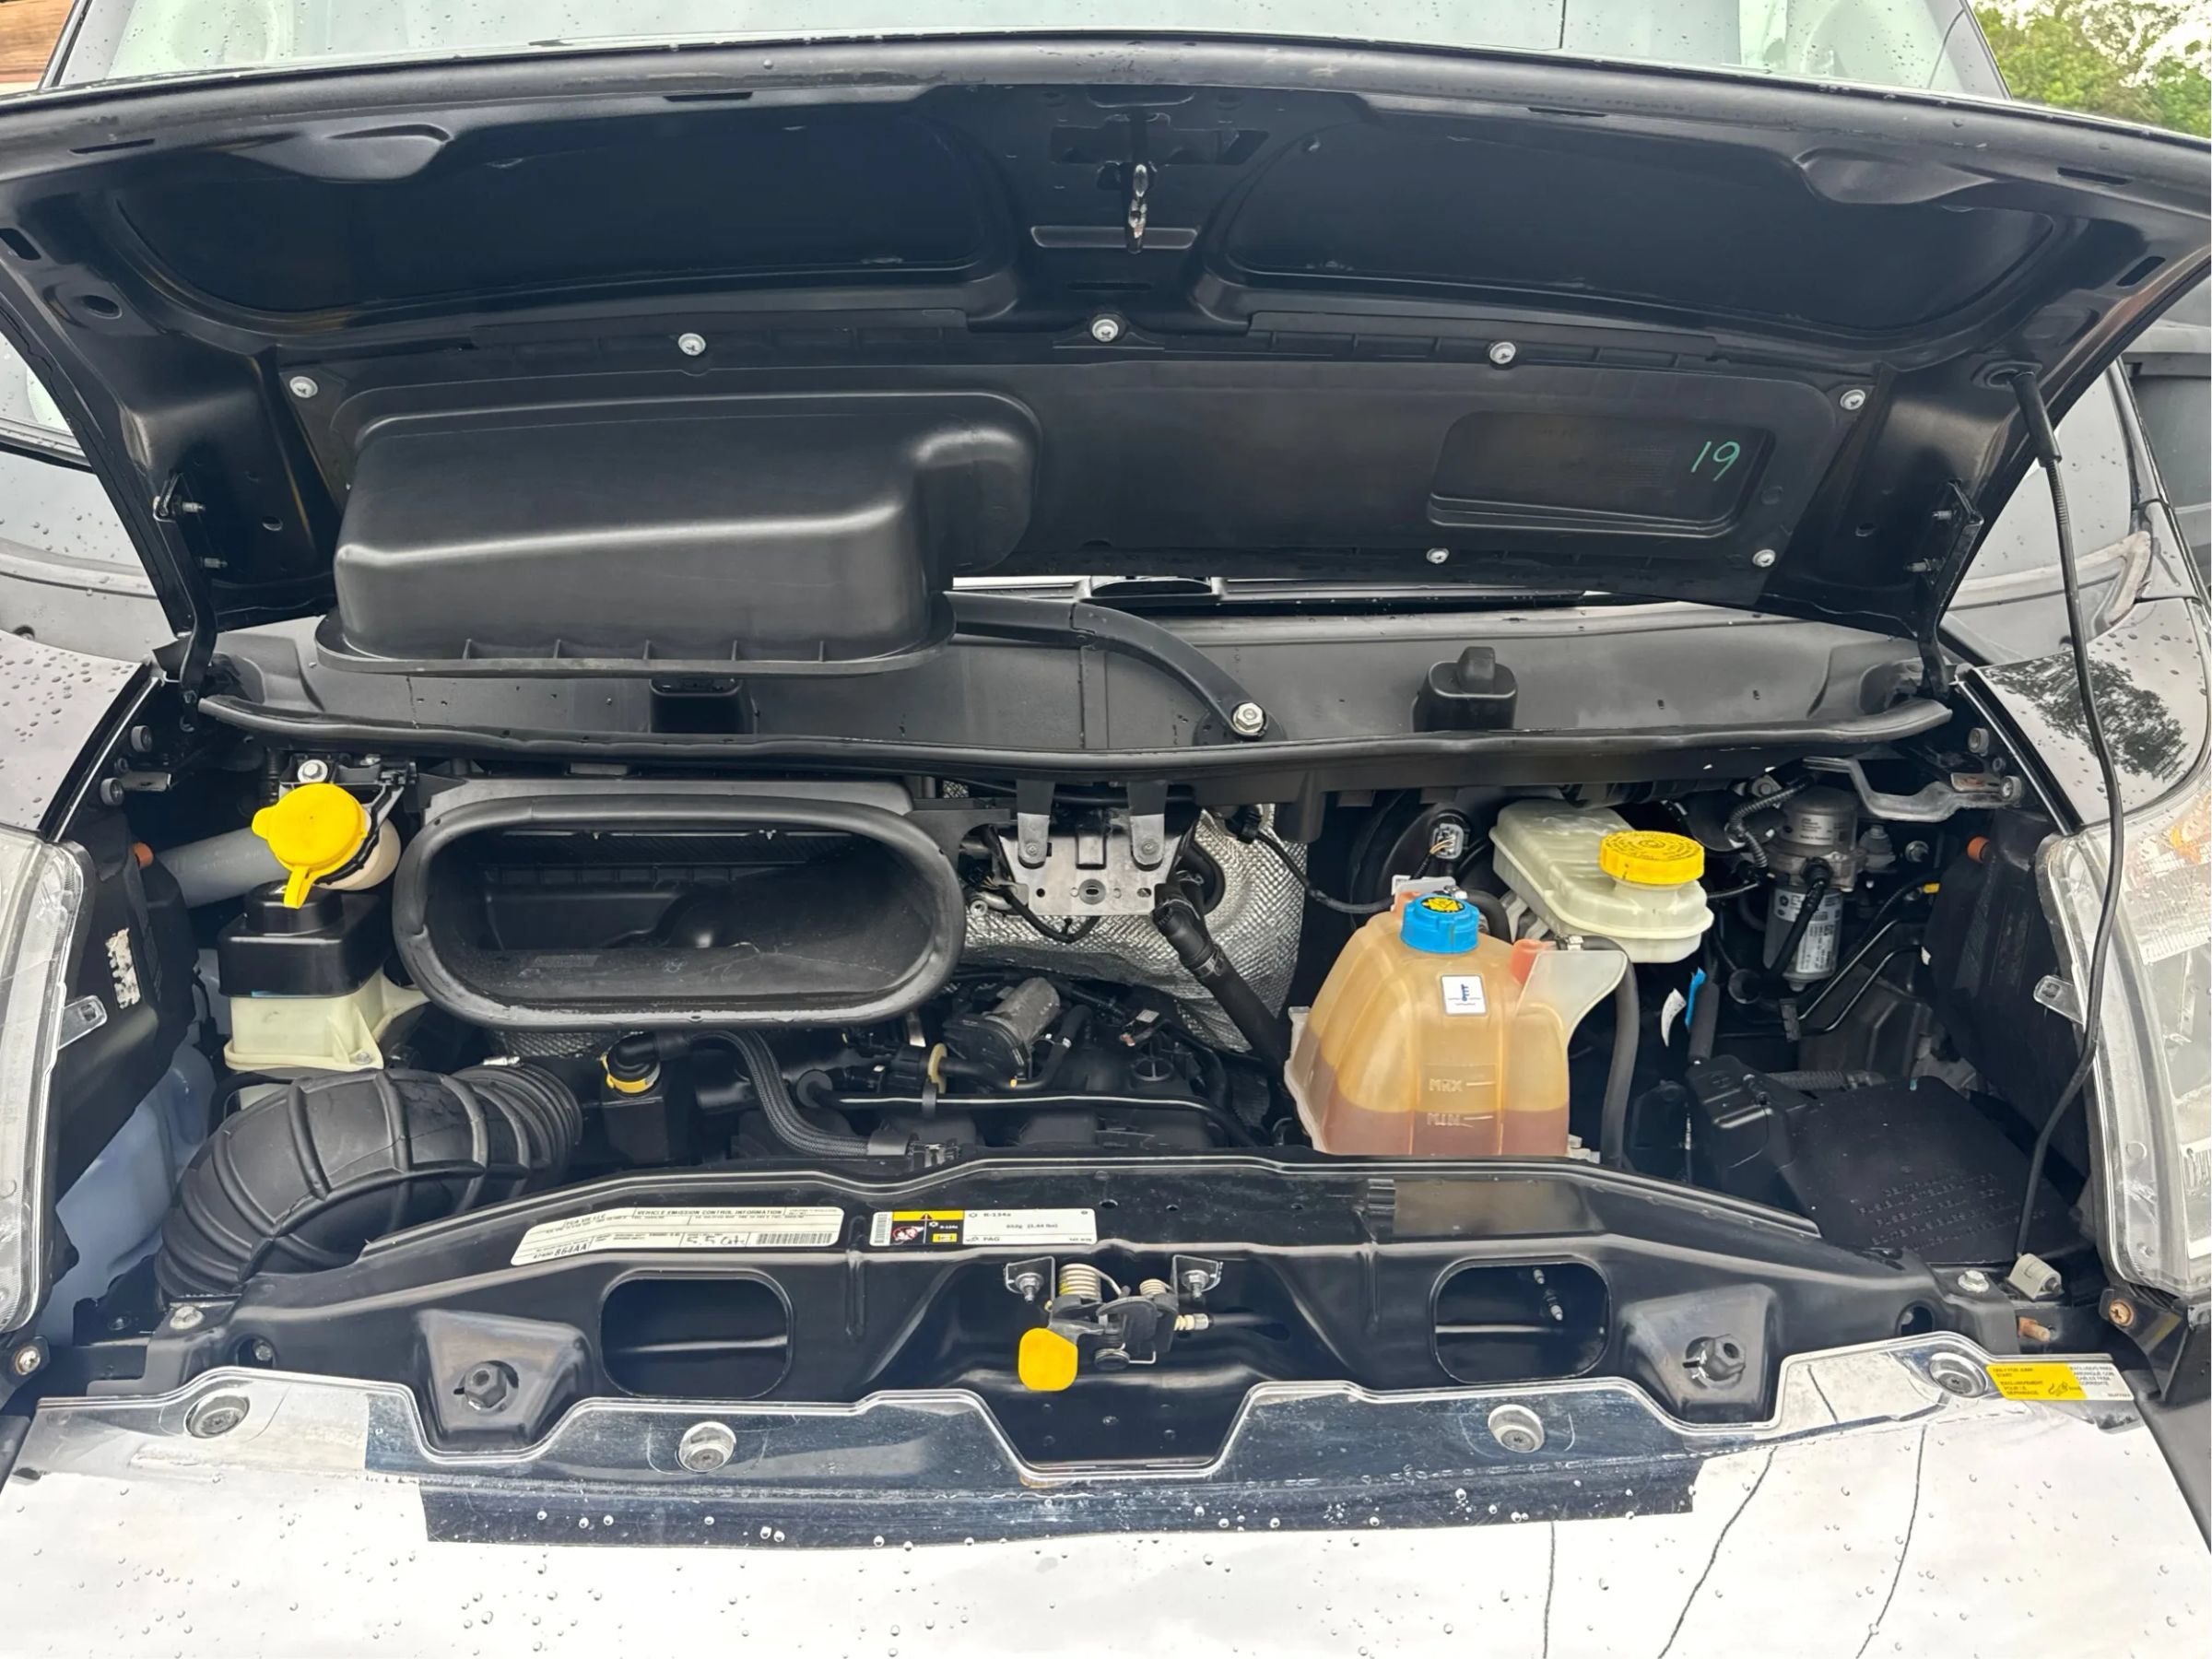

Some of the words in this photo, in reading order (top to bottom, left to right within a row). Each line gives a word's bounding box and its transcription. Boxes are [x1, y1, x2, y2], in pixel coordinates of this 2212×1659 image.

[1691, 441, 1740, 481] 19
[1430, 1078, 1463, 1091] MAX
[1428, 1112, 1460, 1126] MIN
